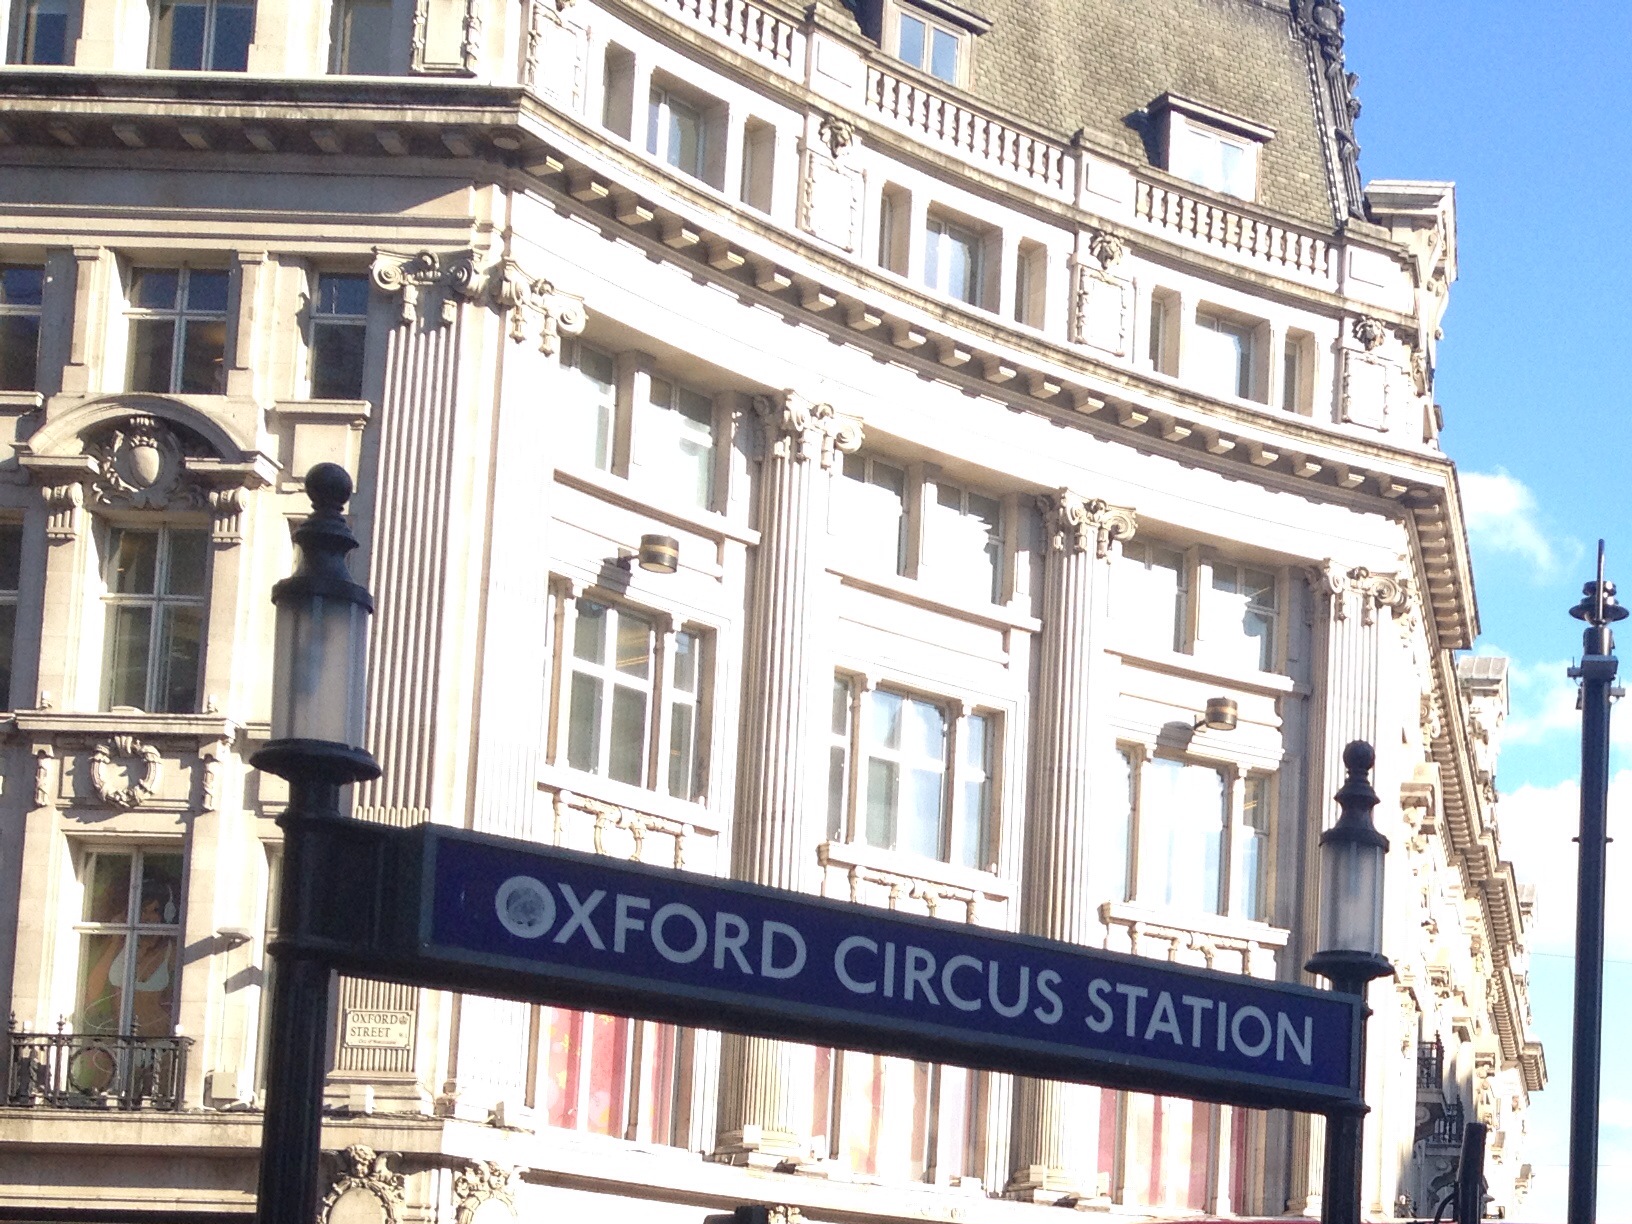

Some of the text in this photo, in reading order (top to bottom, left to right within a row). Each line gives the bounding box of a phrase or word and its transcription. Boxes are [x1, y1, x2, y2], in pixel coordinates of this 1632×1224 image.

[494, 875, 1314, 1066] OXFORD CIRCUS STATION
[352, 1013, 398, 1025] OXFORD
[350, 1026, 391, 1038] STREET
